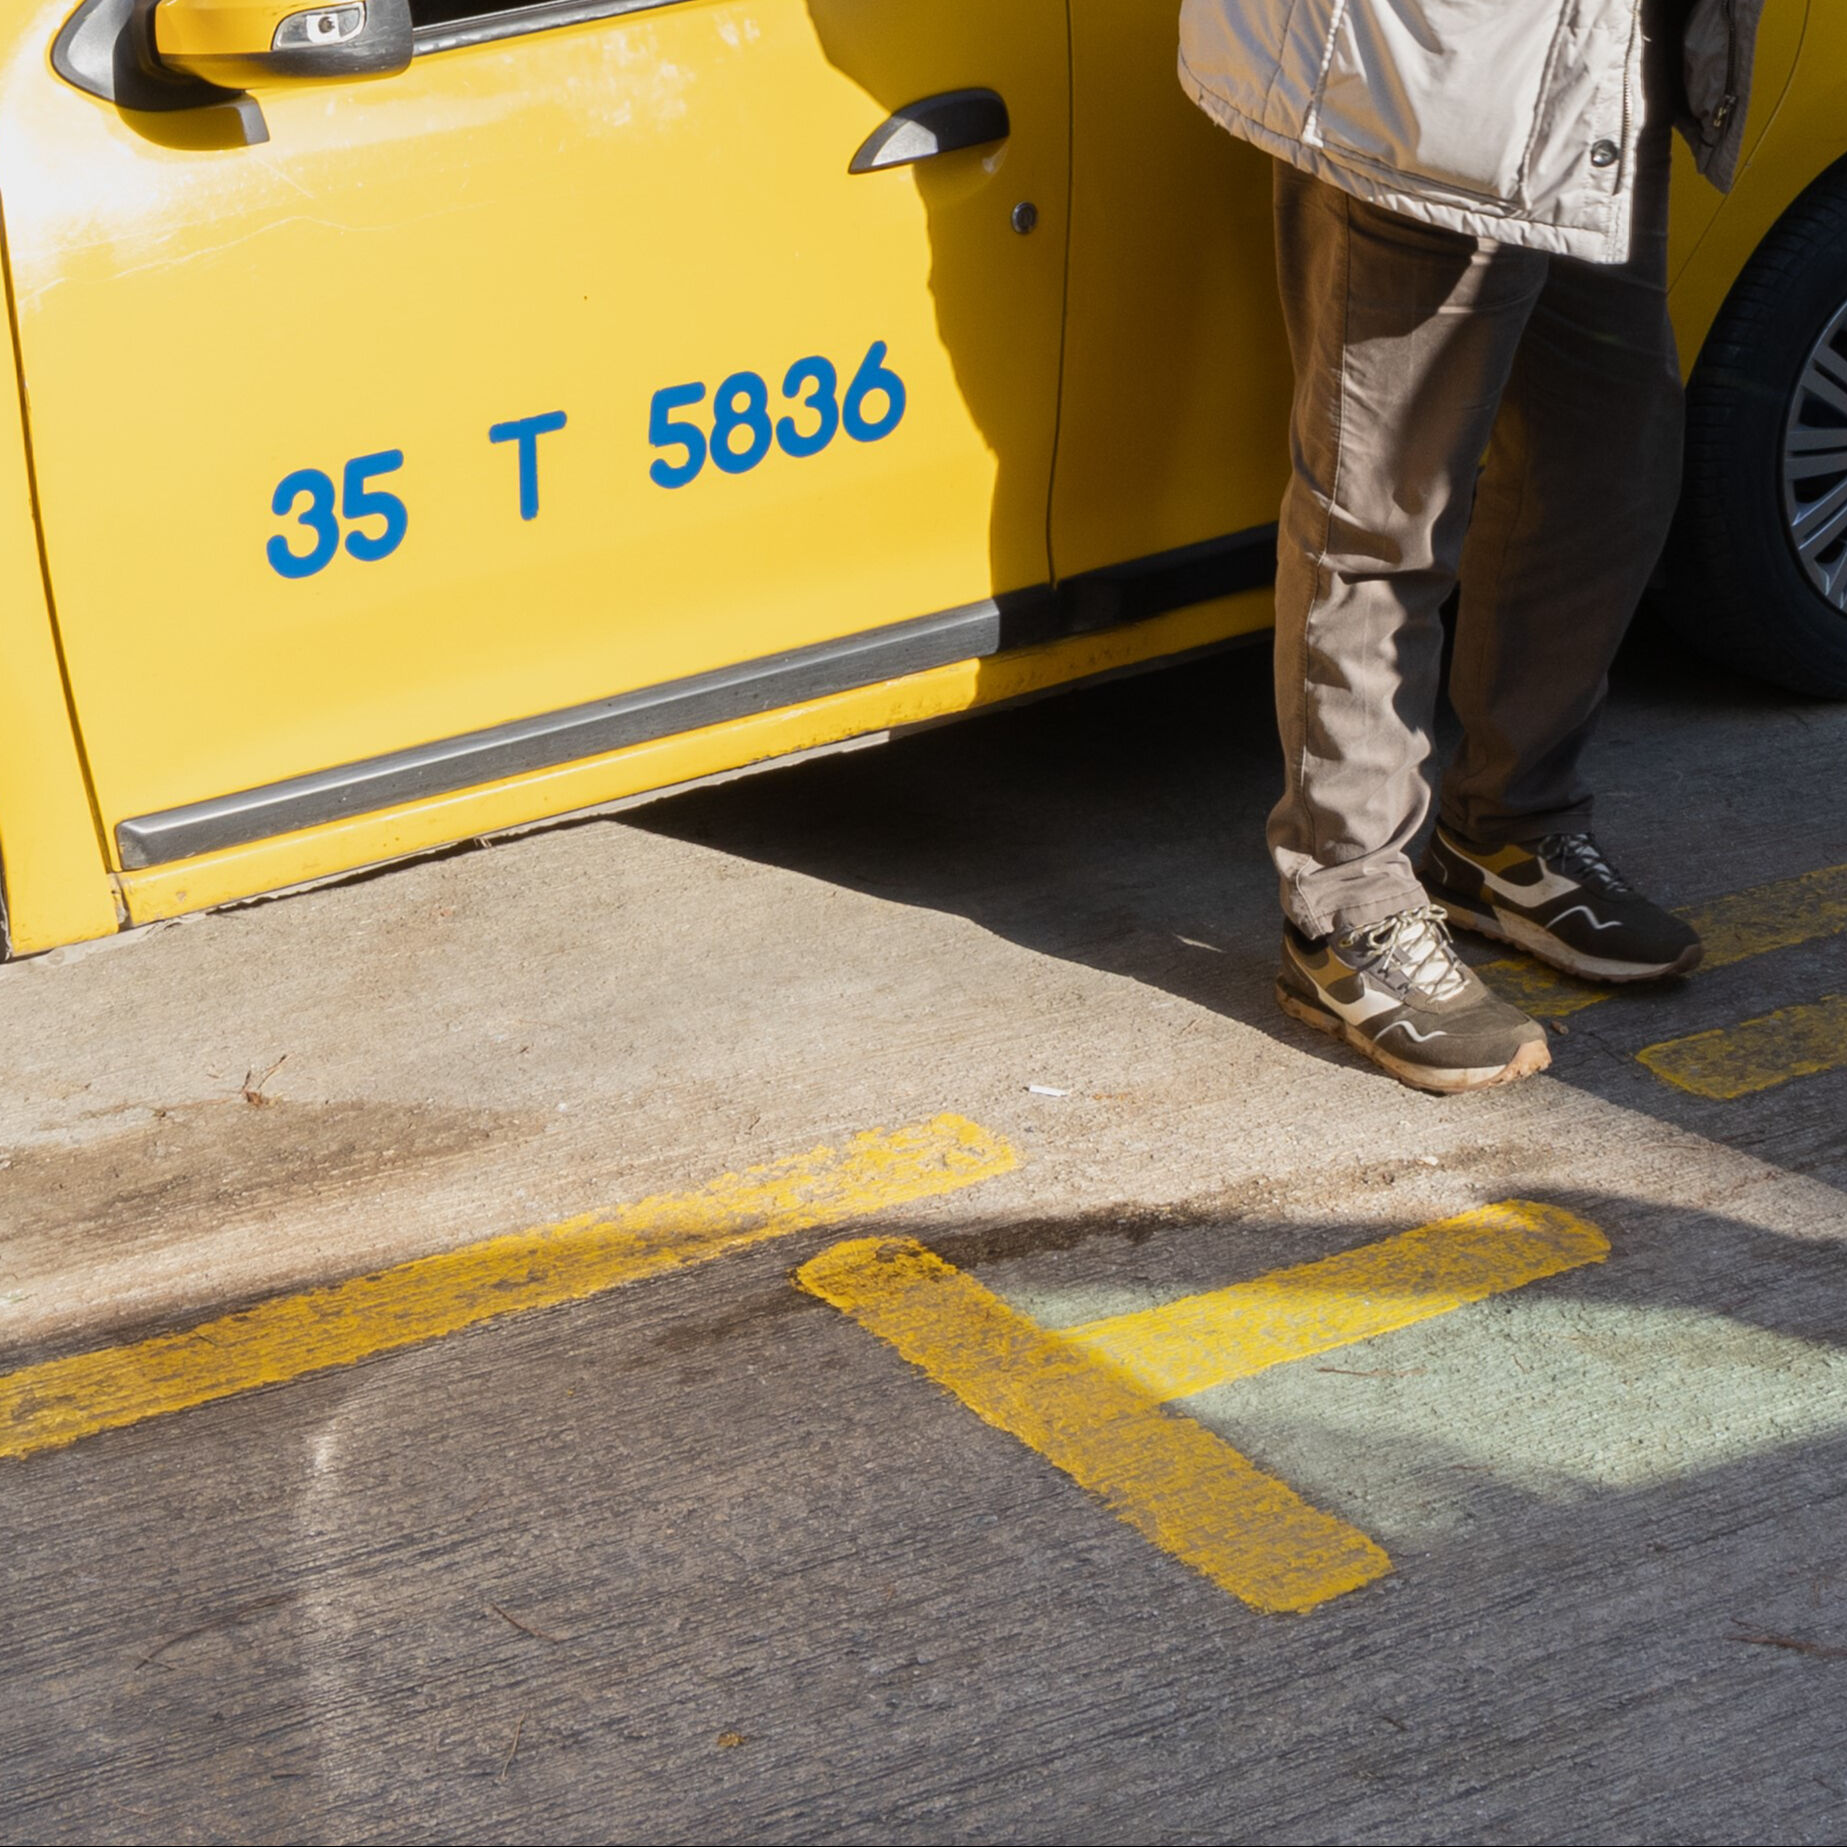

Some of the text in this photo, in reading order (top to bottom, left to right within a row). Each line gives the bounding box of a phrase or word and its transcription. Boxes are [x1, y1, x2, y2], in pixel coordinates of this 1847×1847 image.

[266, 340, 906, 579] 35 T 5836
